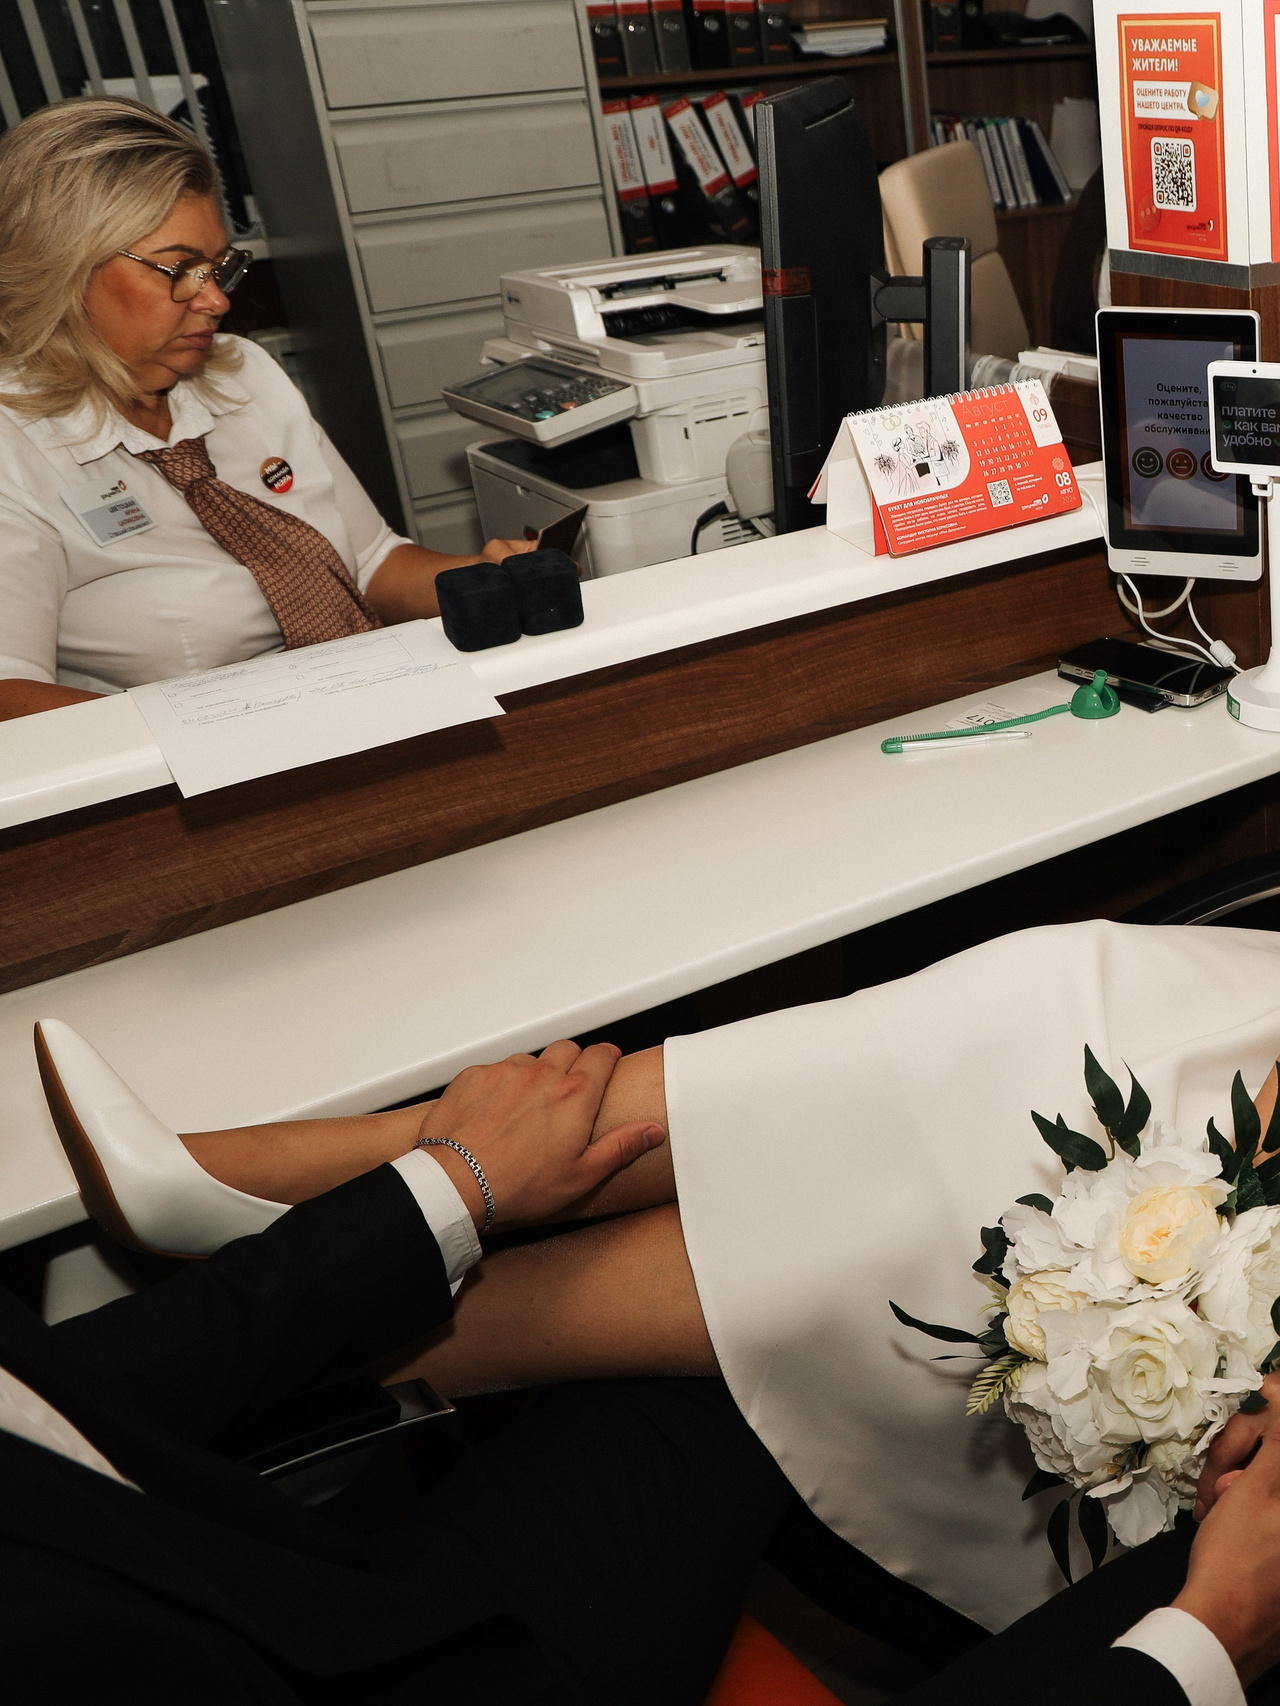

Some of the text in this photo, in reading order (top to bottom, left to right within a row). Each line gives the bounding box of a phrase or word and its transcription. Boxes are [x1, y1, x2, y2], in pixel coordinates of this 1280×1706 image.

[1131, 38, 1197, 52] УВАЖАЕМЫЕ
[1132, 58, 1179, 72] ЖИТЕЛИ!
[1137, 88, 1186, 98] ОЦЕНИТЕ РАБОТУ
[1137, 101, 1186, 111] НАШЕГО ЦЕНТРА,
[1157, 383, 1202, 395] Оцените,
[962, 400, 1008, 418] Август
[1148, 398, 1208, 408] пожалуйста
[1033, 408, 1047, 422] 09
[1158, 412, 1203, 421] качество
[1222, 405, 1276, 418] платите
[1145, 425, 1211, 435] обслуживани
[1234, 421, 1258, 431] как
[1223, 433, 1272, 447] удобно
[273, 474, 292, 489] МЭРА
[1055, 472, 1071, 487] 08
